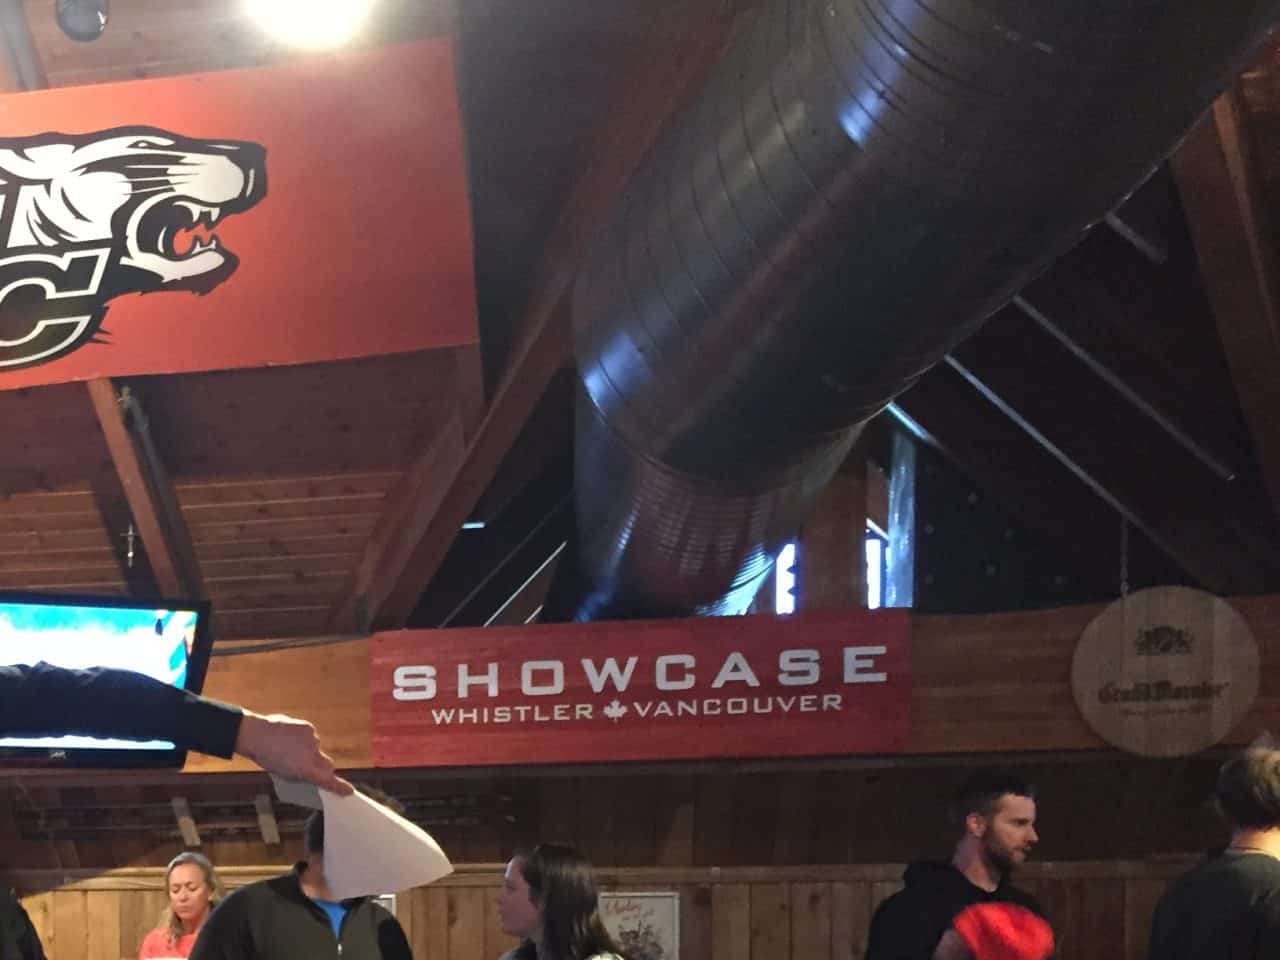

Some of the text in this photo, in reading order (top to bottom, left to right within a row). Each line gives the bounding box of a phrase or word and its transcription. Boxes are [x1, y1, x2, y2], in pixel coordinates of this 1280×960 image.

[392, 645, 888, 701] SHOWCASE
[431, 694, 843, 725] WHISTLER VANCOUVER
